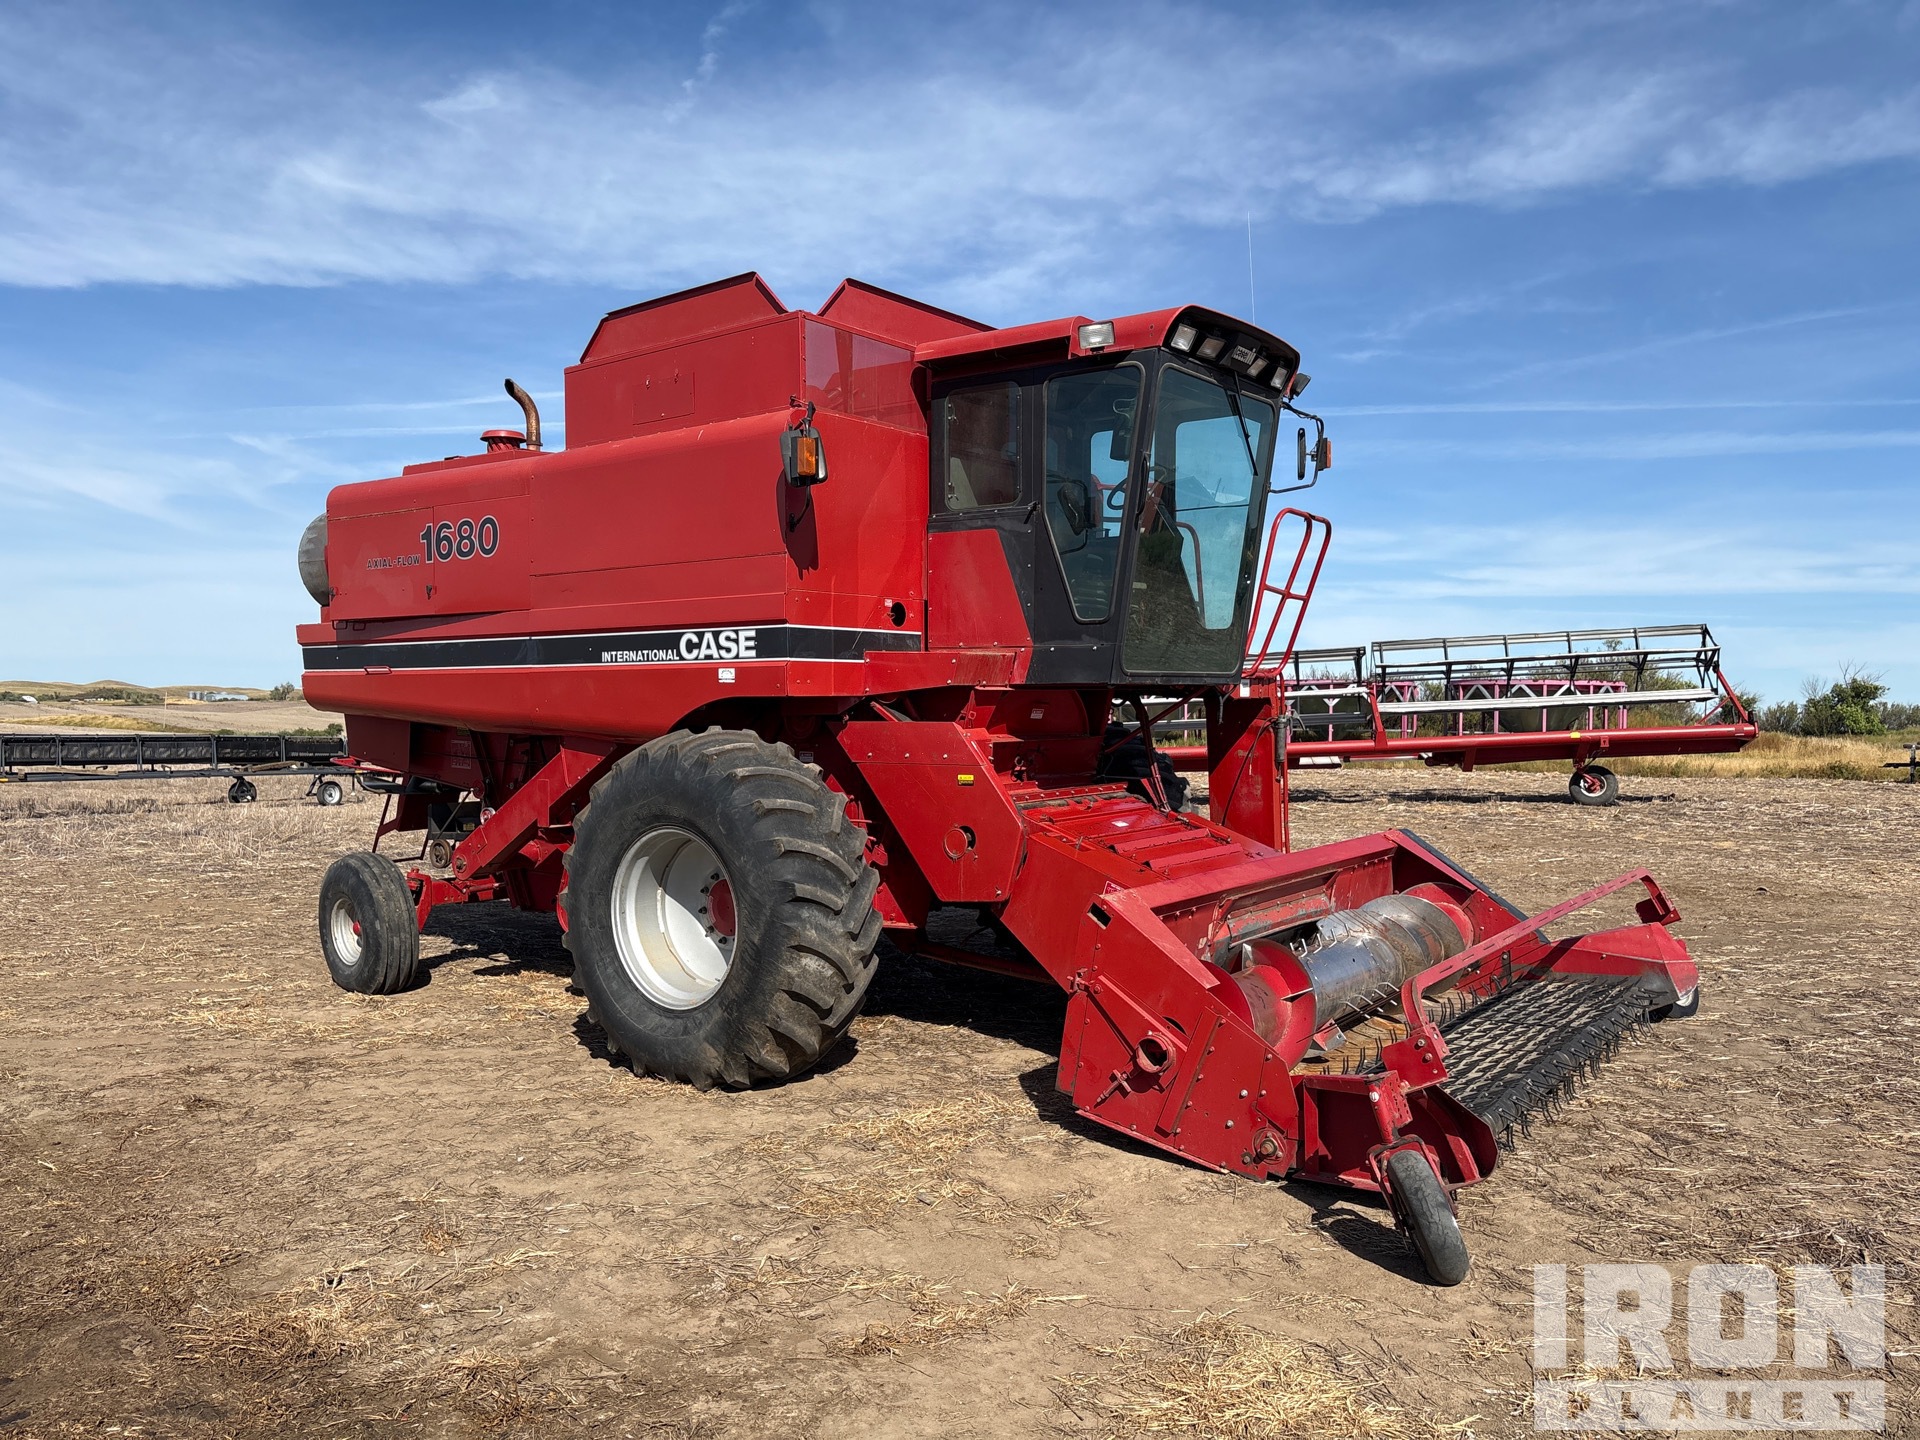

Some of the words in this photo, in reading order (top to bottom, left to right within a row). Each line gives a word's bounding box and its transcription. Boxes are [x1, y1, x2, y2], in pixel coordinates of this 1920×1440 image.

[367, 554, 421, 570] AXIAL-FLOW
[420, 515, 500, 564] 1680
[601, 649, 680, 663] INTERNATIONAL
[679, 629, 757, 660] CASE
